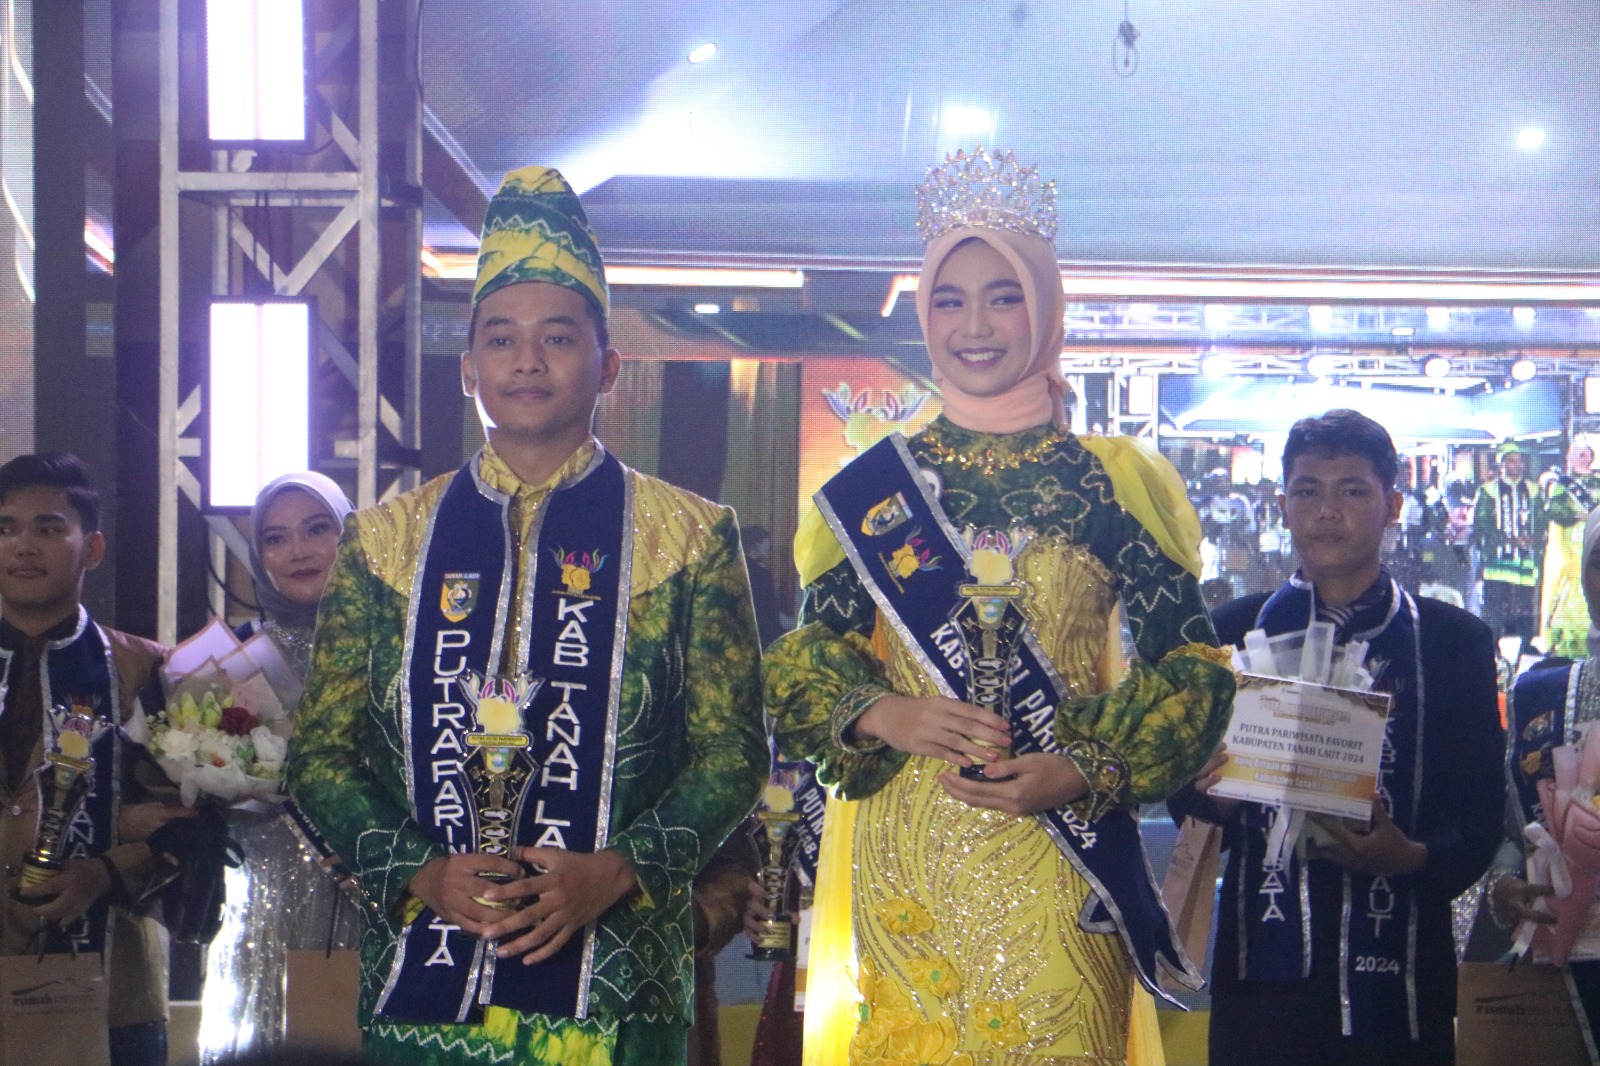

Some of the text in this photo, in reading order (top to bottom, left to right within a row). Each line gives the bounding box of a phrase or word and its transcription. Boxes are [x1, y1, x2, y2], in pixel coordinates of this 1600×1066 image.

[553, 598, 594, 667] KAB
[432, 629, 471, 755] PUTRA
[540, 681, 588, 791] TANAH
[1232, 735, 1364, 763] KABUPATEN TANAH LAUT 2024
[1240, 723, 1363, 751] PUTRA PARIWISATA FAVORIT
[1355, 956, 1400, 975] 2024
